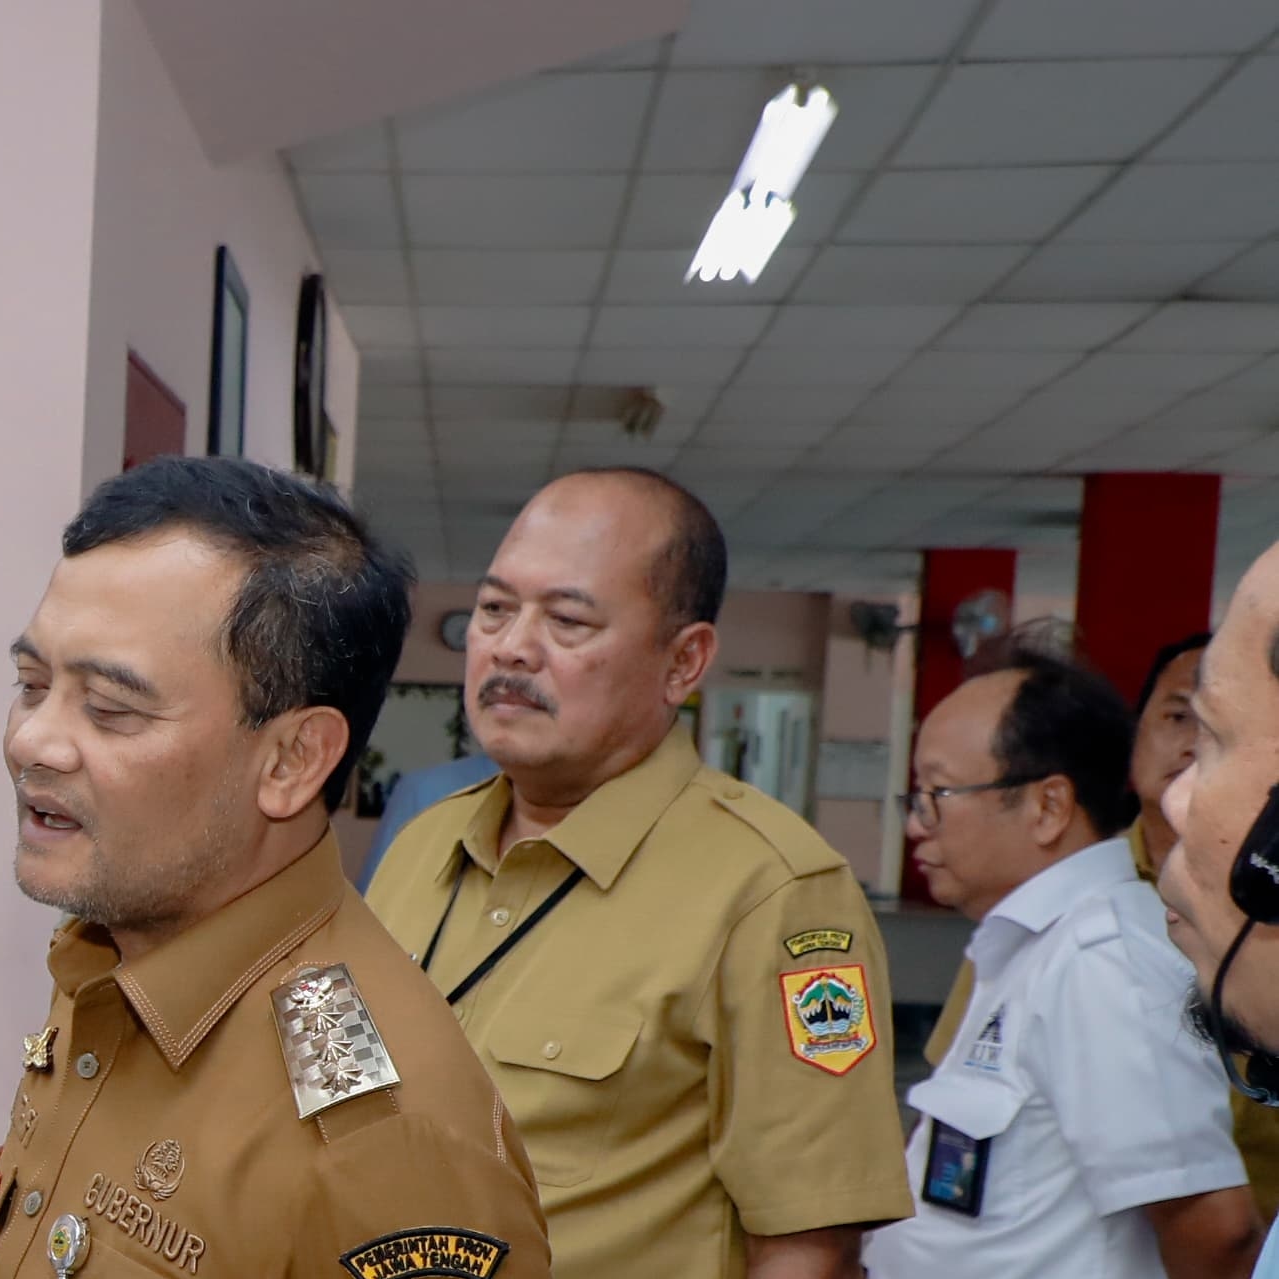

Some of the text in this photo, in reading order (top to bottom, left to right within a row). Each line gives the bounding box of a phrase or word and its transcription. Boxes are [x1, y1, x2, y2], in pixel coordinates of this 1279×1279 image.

[84, 1172, 206, 1276] GUBERNUR
[355, 1235, 493, 1273] PEMERINTAH PROV.
[420, 1250, 484, 1275] TENGAH
